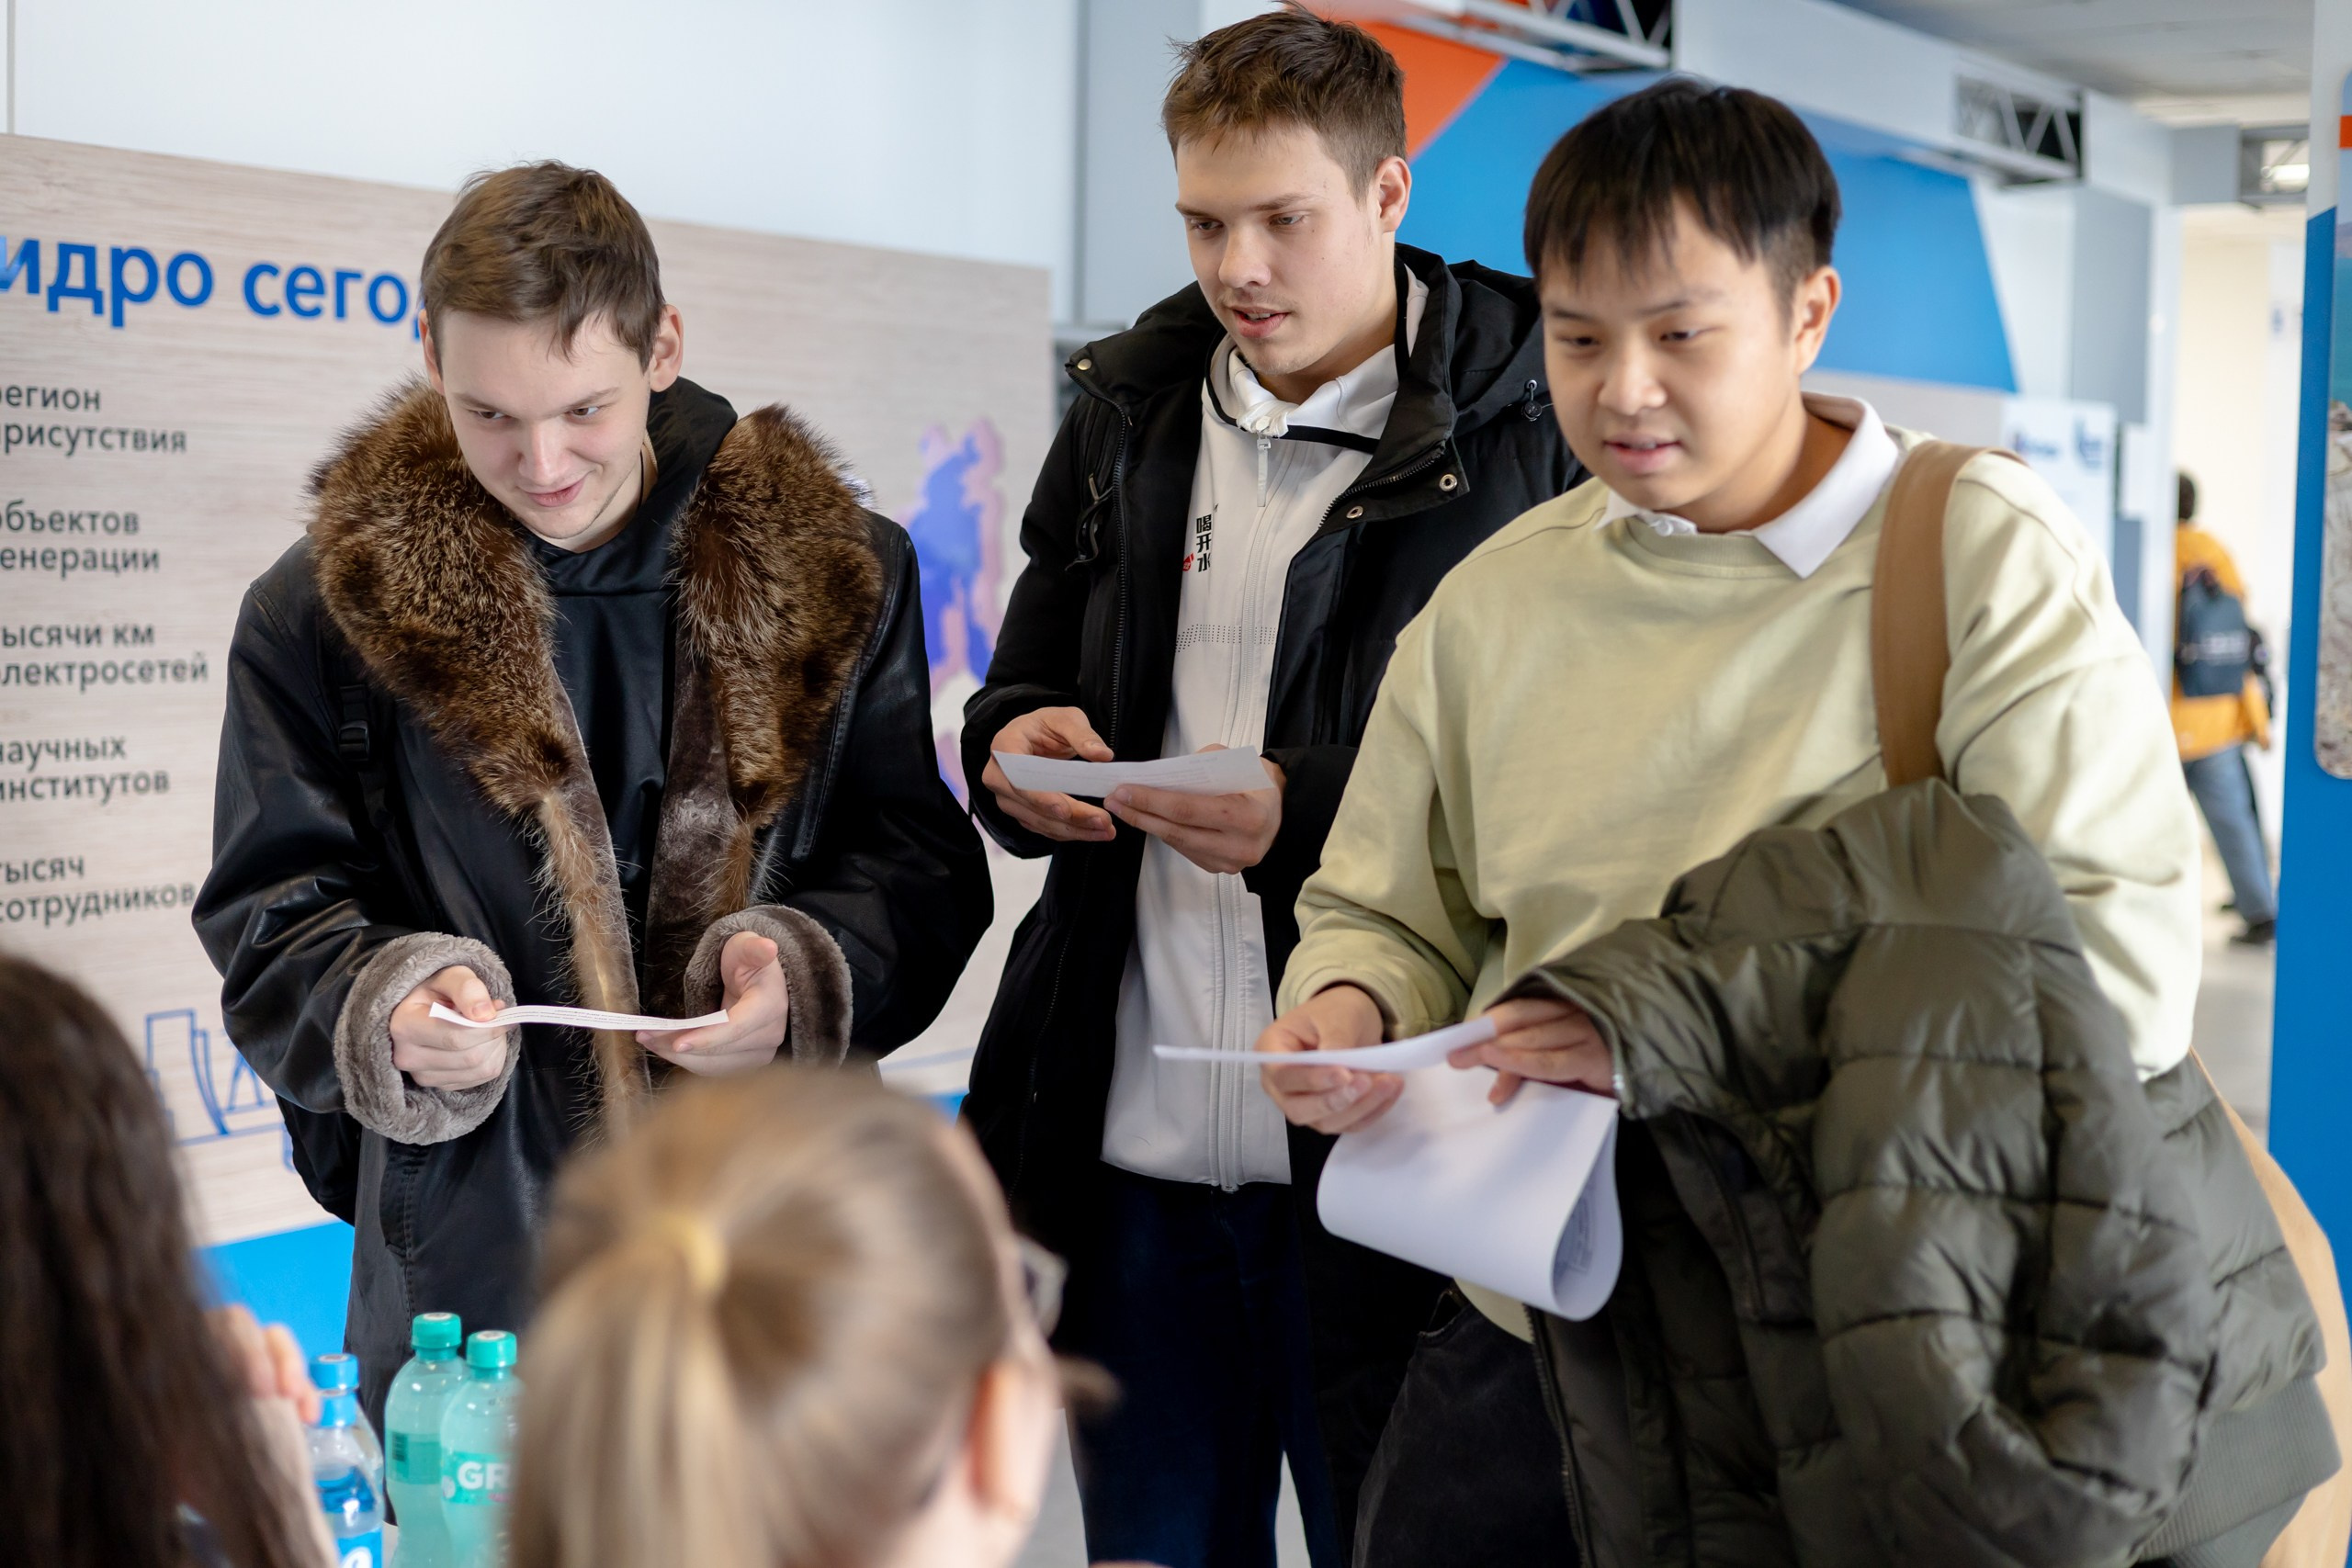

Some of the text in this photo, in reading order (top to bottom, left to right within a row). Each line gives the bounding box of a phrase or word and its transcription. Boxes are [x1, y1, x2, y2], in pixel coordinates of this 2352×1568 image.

[243, 262, 421, 340] сего
[0, 385, 100, 411] егион
[0, 423, 187, 457] рисутствия
[0, 499, 139, 534] бъектов
[1196, 514, 1212, 572] 喝开水
[0, 547, 159, 580] енерации
[2, 625, 154, 648] ысячи км
[0, 652, 208, 694] лектросетей
[0, 856, 85, 884] ысяч
